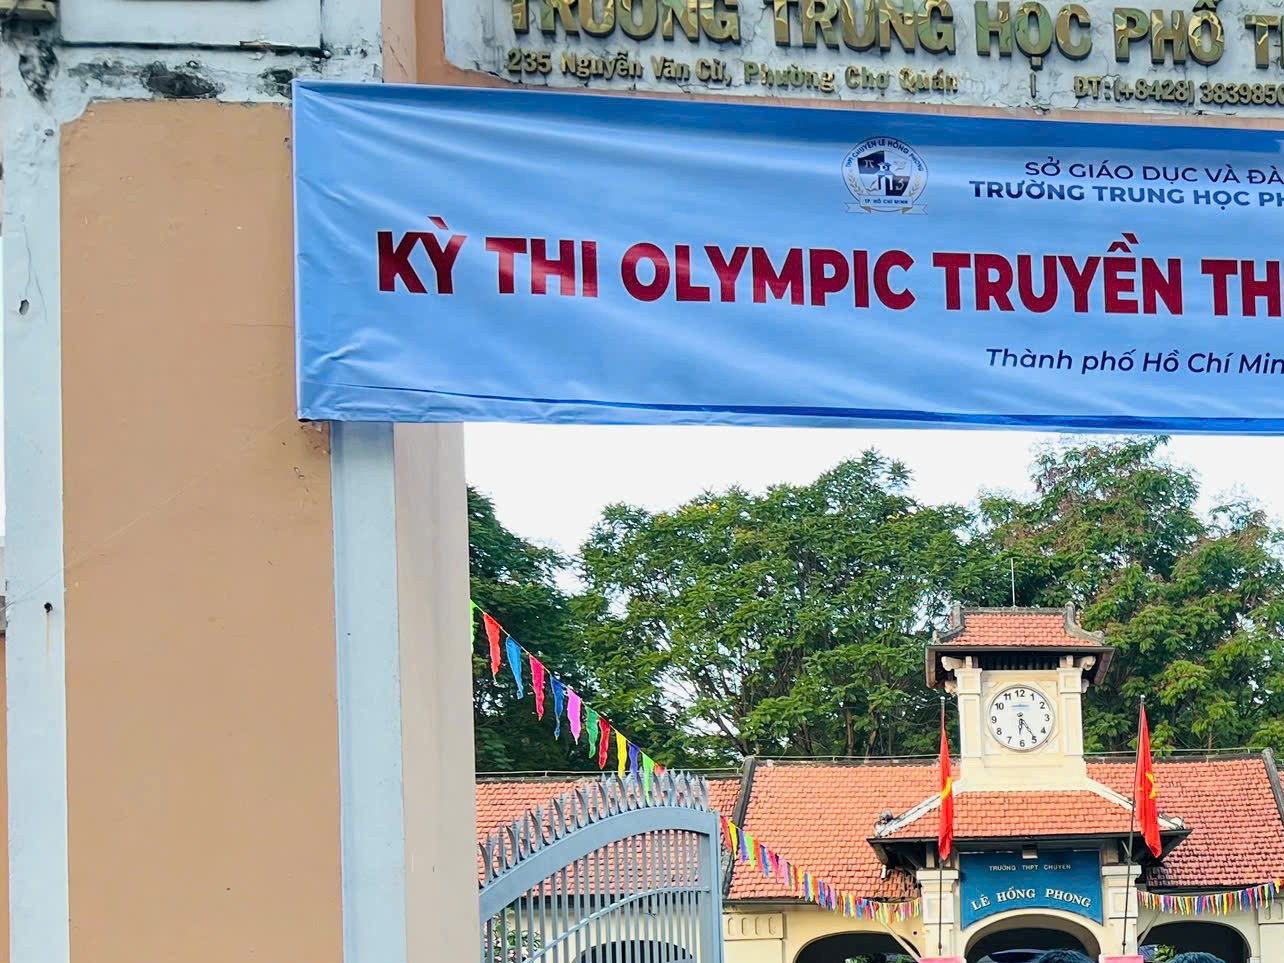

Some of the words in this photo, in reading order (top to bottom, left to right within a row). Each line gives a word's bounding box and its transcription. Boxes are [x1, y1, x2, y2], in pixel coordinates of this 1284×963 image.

[764, 0, 956, 55] TRUNG
[974, 0, 1093, 70] HỌC
[508, 50, 552, 74] 235
[561, 51, 643, 80] Nguyễn
[651, 55, 690, 81] Văn
[743, 61, 835, 93] Phường
[845, 66, 891, 96] Chợ
[899, 66, 959, 95] Quán
[1025, 156, 1061, 177] SỞ
[1069, 160, 1134, 180] GIÁO
[1142, 166, 1198, 185] DỤC
[1204, 164, 1241, 184] VÀ
[969, 178, 1085, 201] TRƯỜNG
[1092, 185, 1185, 204] TRUNG
[1193, 189, 1251, 210] HỌC
[377, 216, 467, 295] KỲ
[485, 236, 598, 298] THI
[620, 242, 916, 310] OLYMPIC
[932, 232, 1184, 315] TRUYỀN
[985, 347, 1073, 371] Thành
[1081, 348, 1138, 376] phố
[1142, 347, 1179, 373] Hồ
[1187, 350, 1232, 374] Chí
[995, 702, 1004, 711] 10
[1003, 692, 1012, 700] 11
[1014, 689, 1025, 698] 12
[970, 893, 991, 911] LÊ
[995, 886, 1036, 903] HỒNG
[1045, 888, 1091, 908] PHONG
